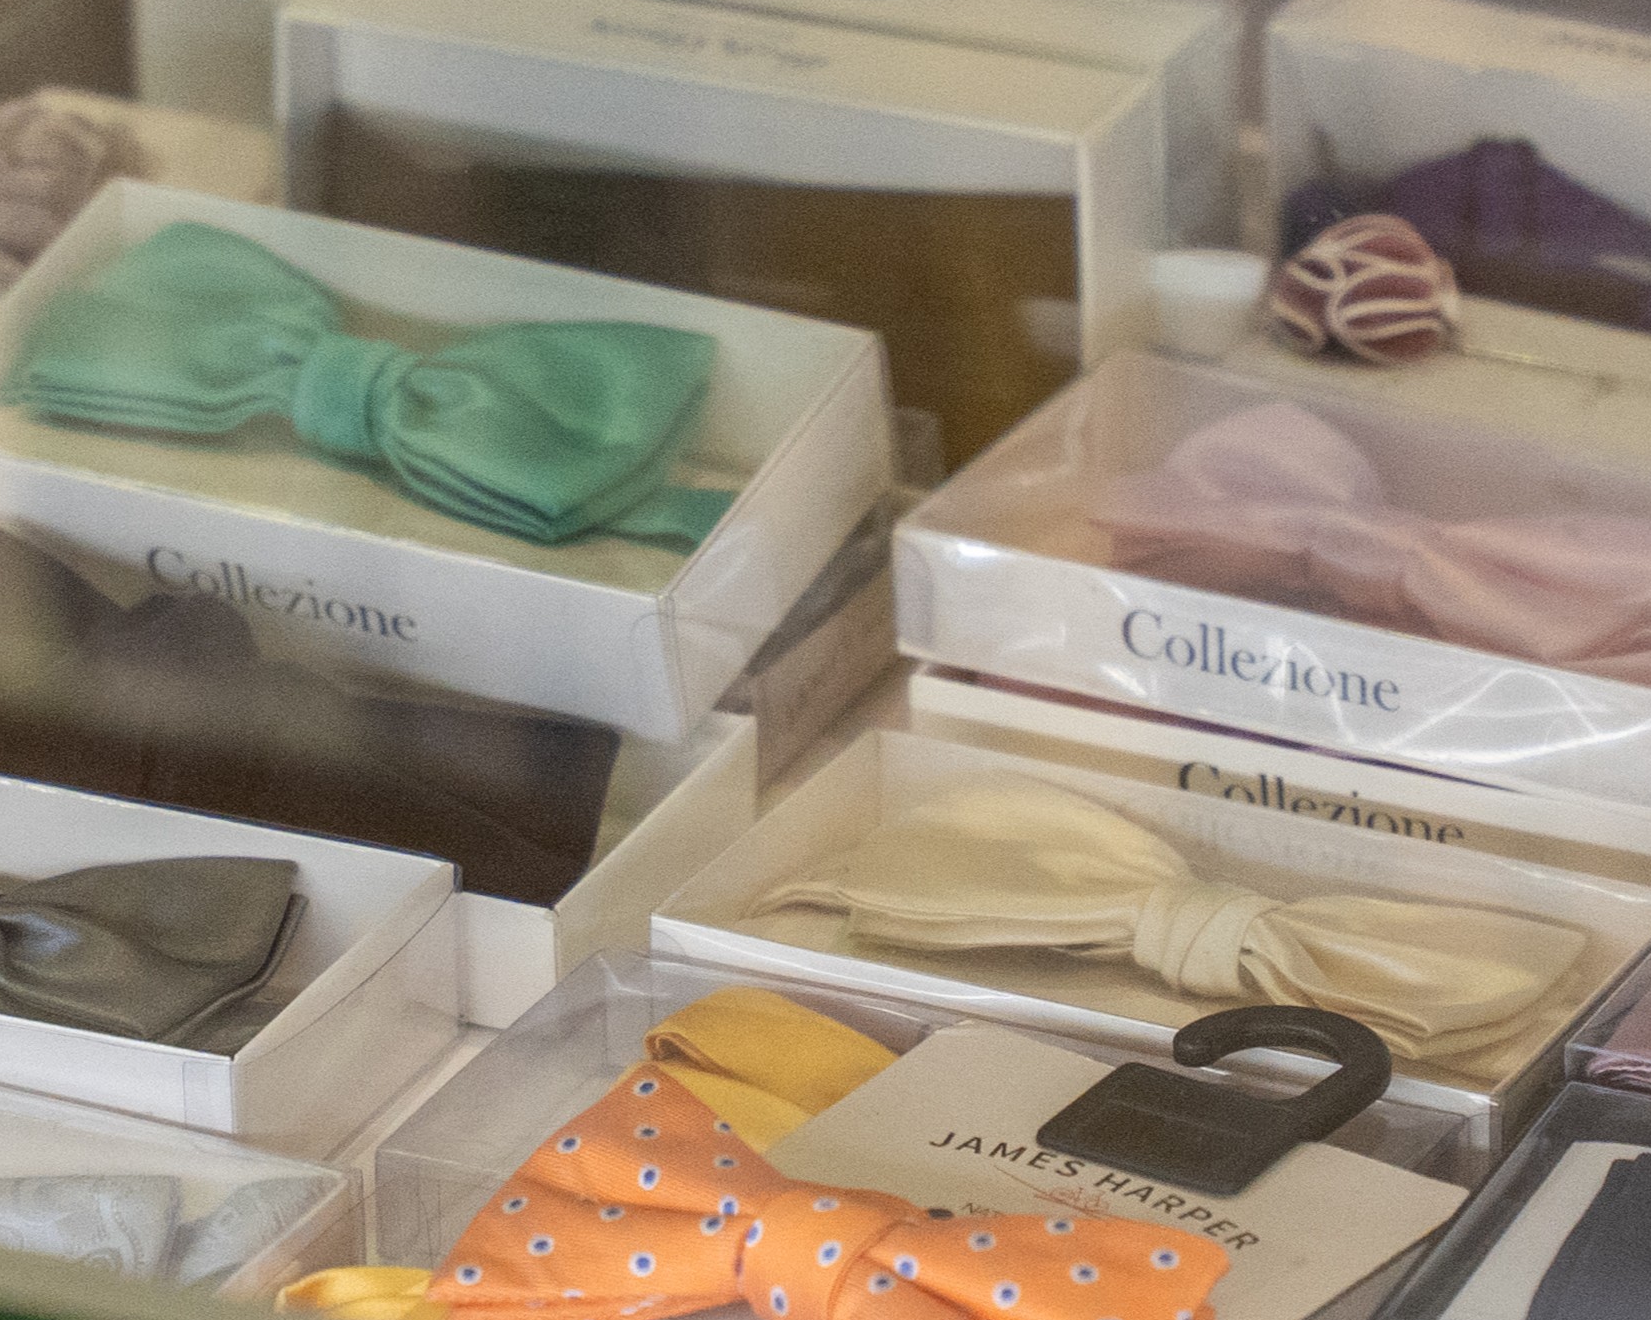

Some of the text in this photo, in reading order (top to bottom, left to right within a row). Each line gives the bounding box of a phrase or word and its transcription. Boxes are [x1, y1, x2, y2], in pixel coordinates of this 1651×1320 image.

[146, 546, 417, 643] Collezione
[1121, 608, 1402, 713] Collezione
[928, 1131, 1260, 1251] JAMES HARPER
